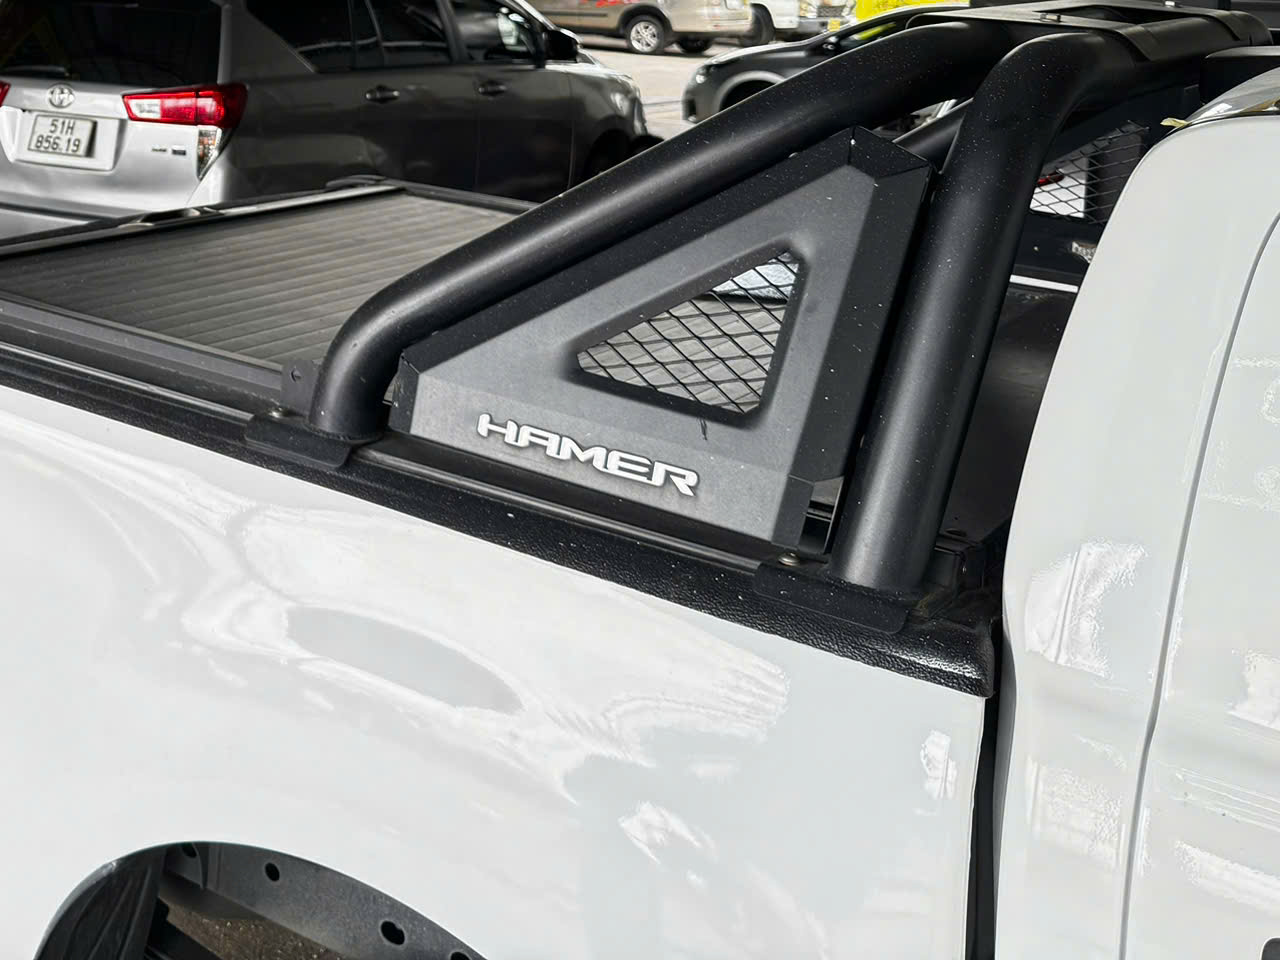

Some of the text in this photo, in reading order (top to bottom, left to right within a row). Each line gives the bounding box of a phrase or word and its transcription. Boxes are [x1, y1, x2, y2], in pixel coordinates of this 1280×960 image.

[49, 118, 75, 136] 51H
[34, 135, 81, 153] 856.19
[476, 413, 700, 497] HAMER
